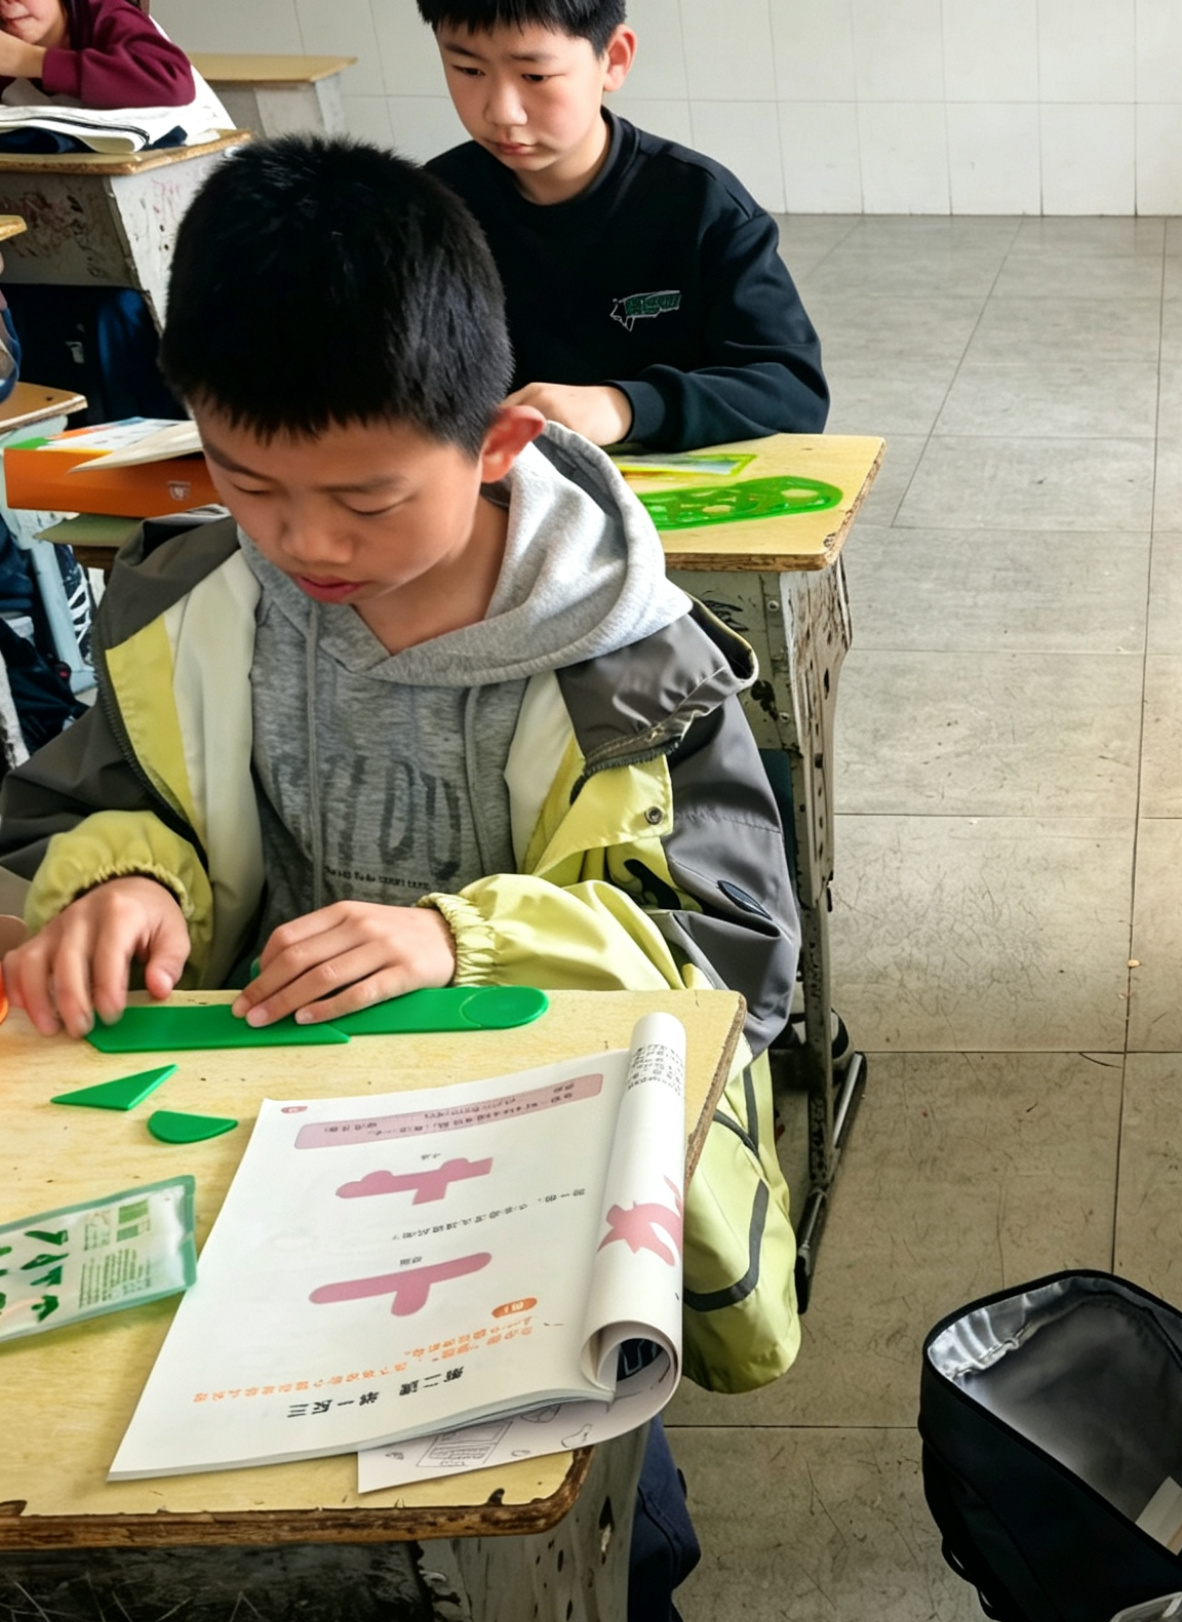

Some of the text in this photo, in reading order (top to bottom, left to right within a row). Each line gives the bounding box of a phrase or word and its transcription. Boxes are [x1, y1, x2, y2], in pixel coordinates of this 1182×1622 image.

[399, 1366, 464, 1396] 第二课
[287, 1391, 379, 1418] 举一反三
